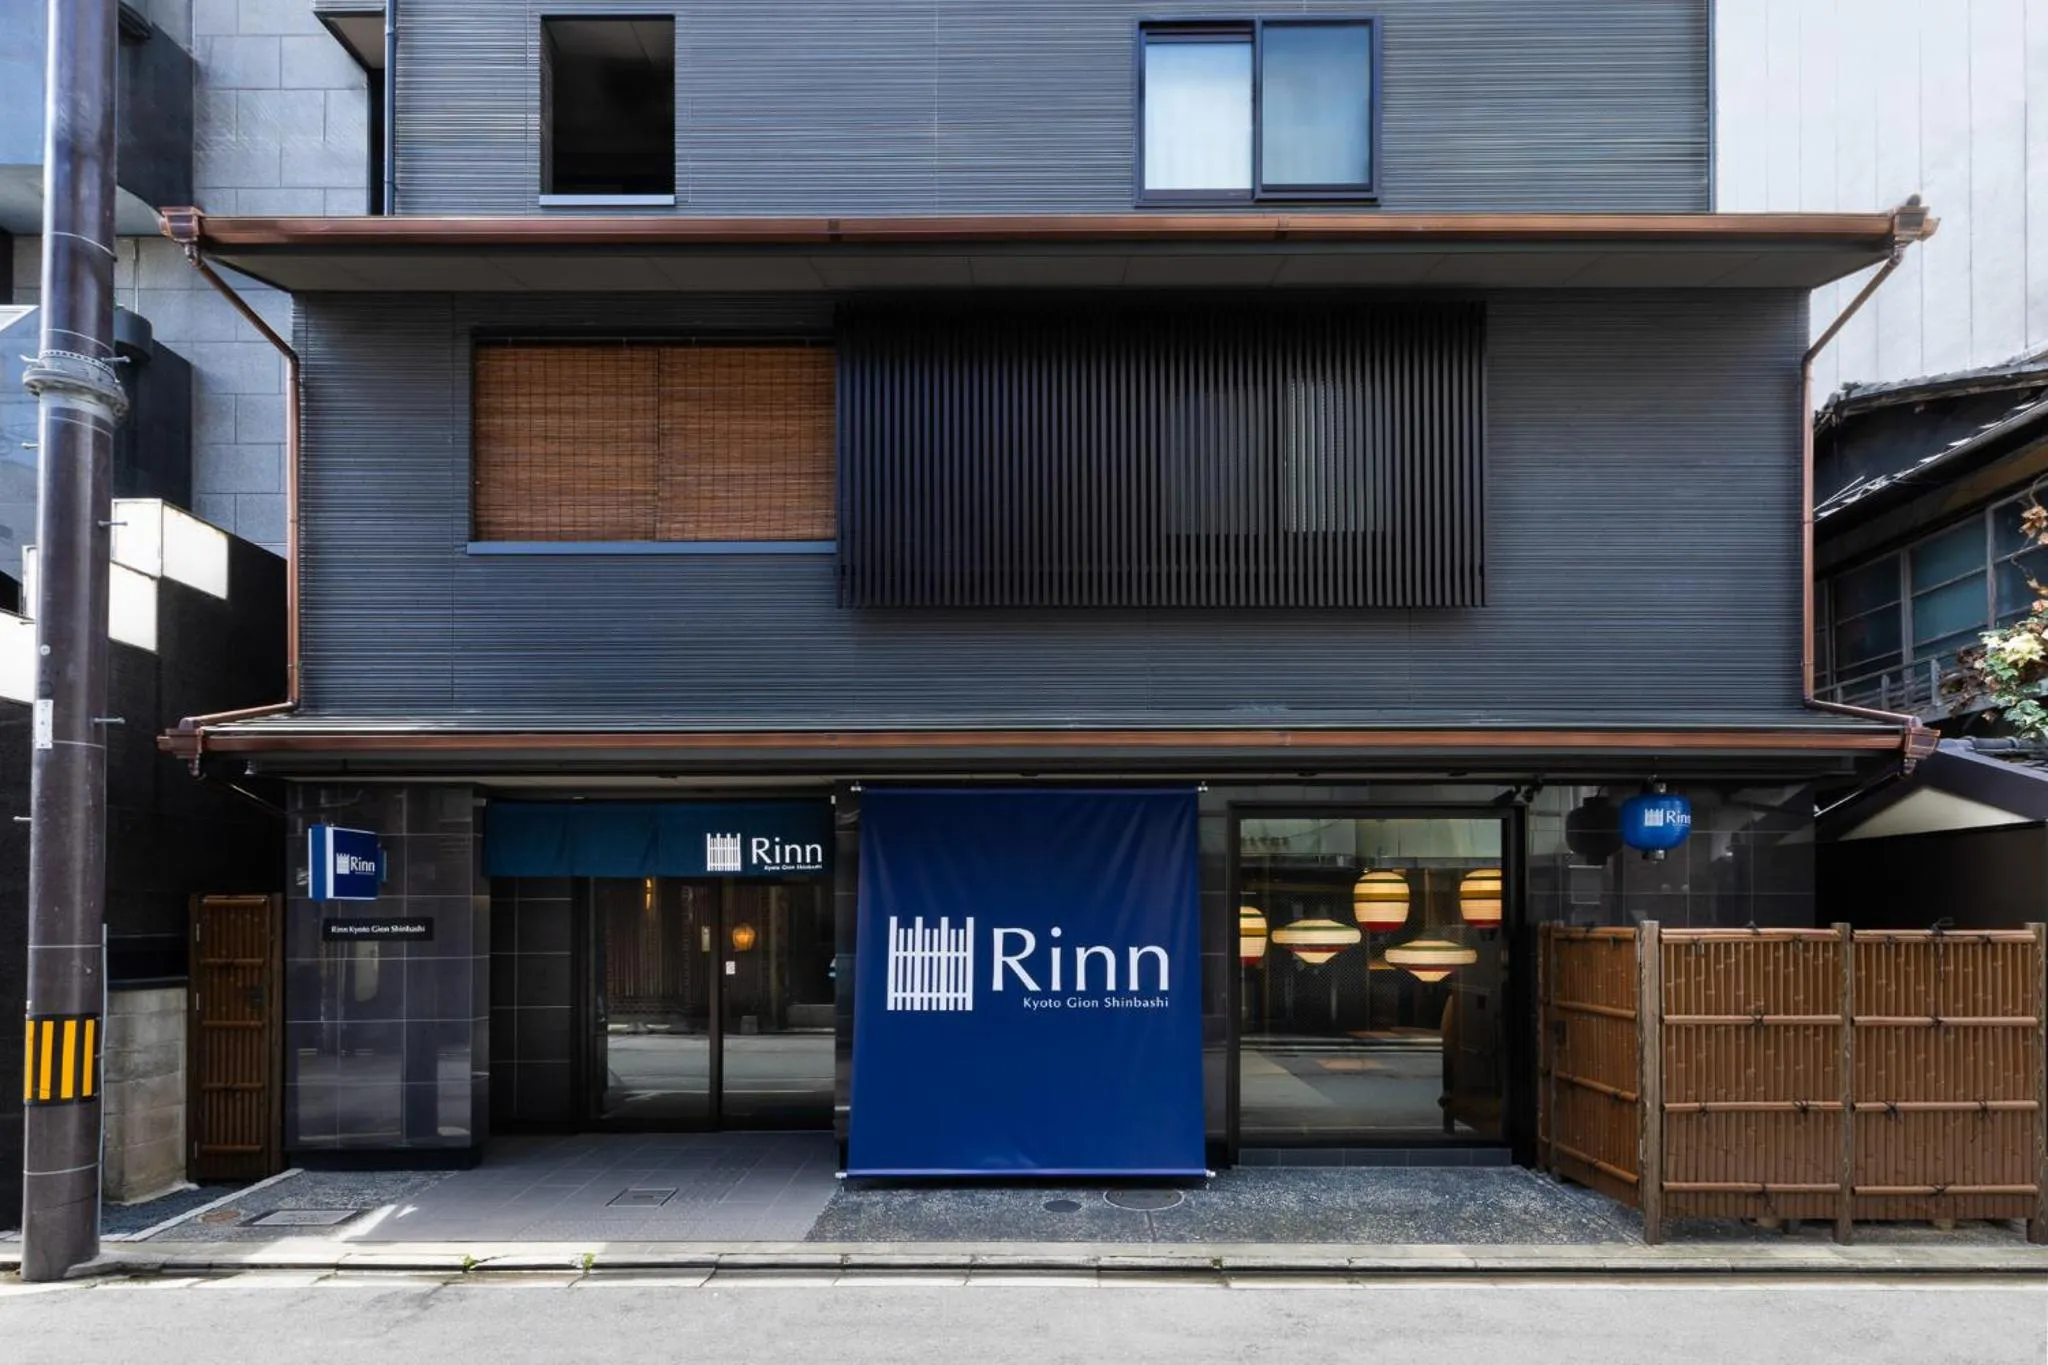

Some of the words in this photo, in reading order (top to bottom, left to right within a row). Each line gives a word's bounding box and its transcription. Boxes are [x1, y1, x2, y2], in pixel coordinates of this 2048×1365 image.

[751, 837, 822, 864] Rinn
[350, 856, 375, 872] Rinn
[349, 926, 370, 935] Kyoto
[371, 925, 390, 933] Gion
[992, 926, 1169, 991] Rinn
[1023, 997, 1062, 1011] Kyoto
[1066, 997, 1099, 1008] Gion
[1104, 997, 1169, 1008] Shinbashi
